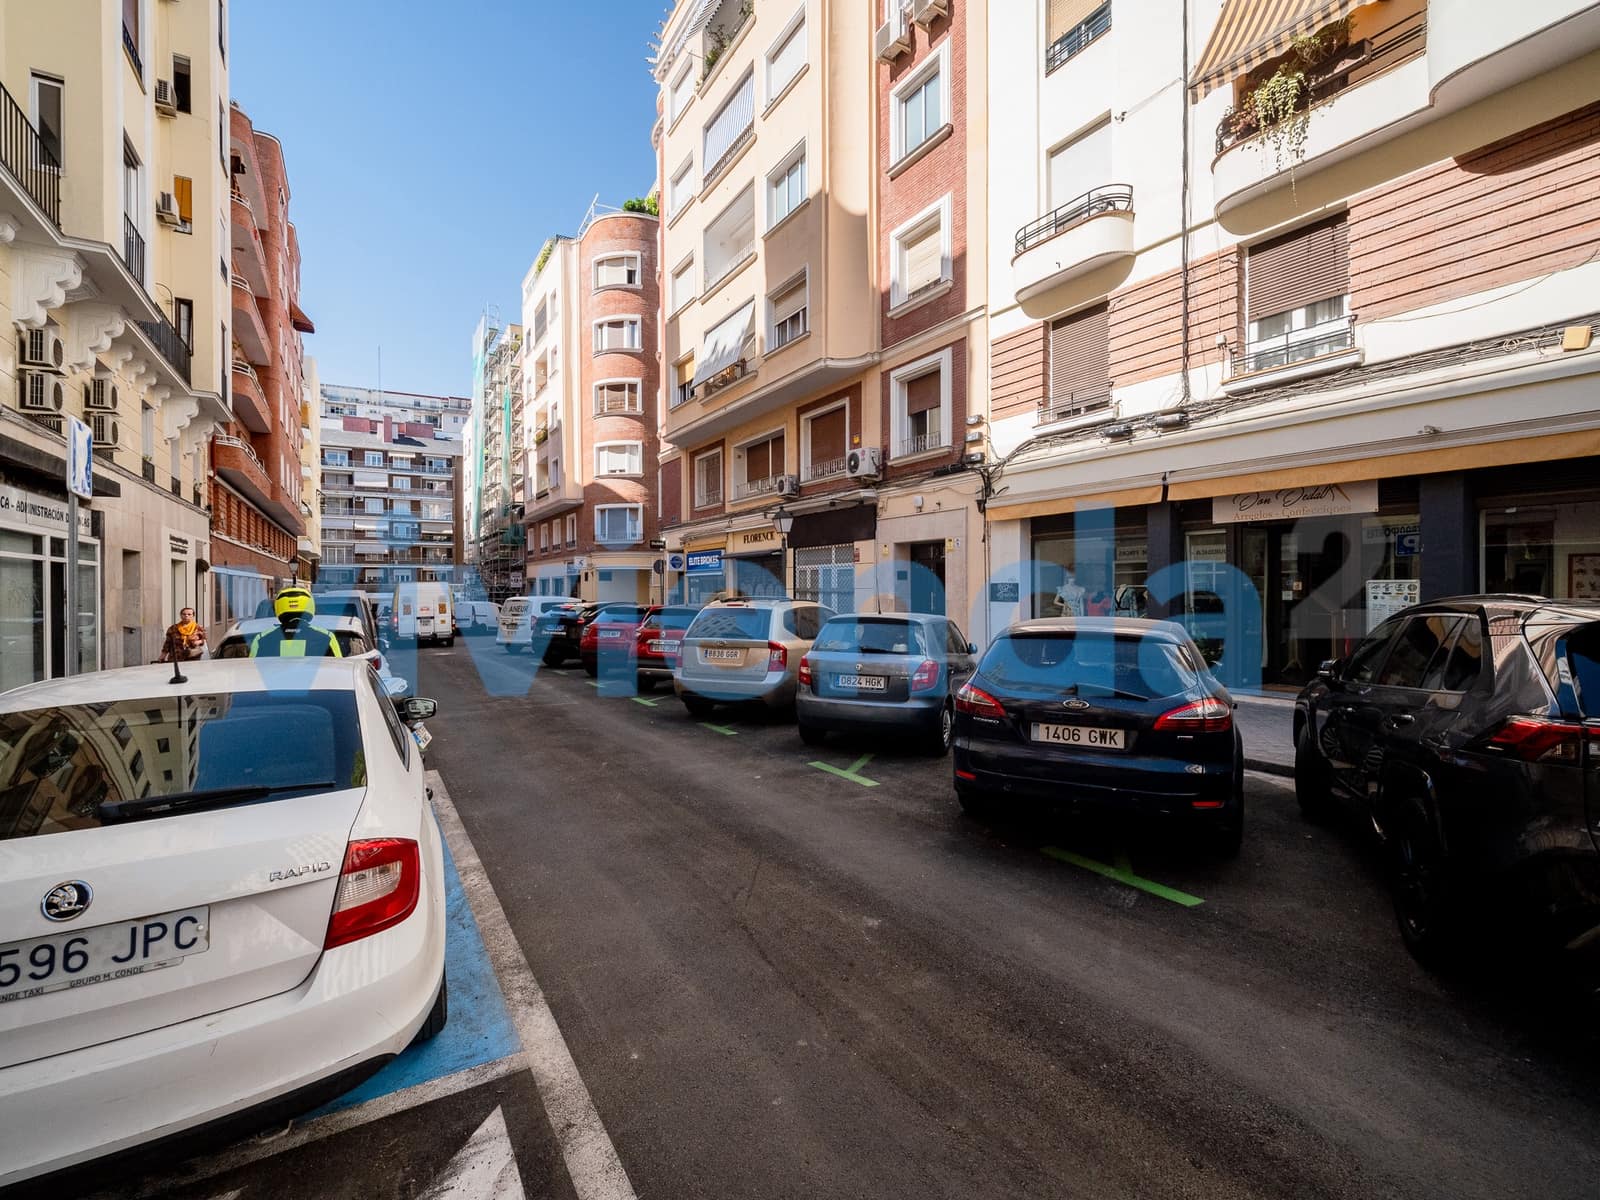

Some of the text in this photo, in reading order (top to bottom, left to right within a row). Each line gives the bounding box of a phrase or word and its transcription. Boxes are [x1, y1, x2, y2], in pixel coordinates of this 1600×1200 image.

[1282, 504, 1352, 517] Confecciones
[743, 531, 774, 545] FLORENCE
[841, 675, 883, 687] 0824 HGK
[1045, 725, 1119, 746] 1406 GWK
[269, 861, 331, 882] RAPID
[0, 915, 199, 987] 596 JPC
[22, 986, 44, 997] TAXI
[69, 975, 101, 988] GRUPO
[102, 972, 114, 982] M.
[114, 965, 145, 978] CONDE
